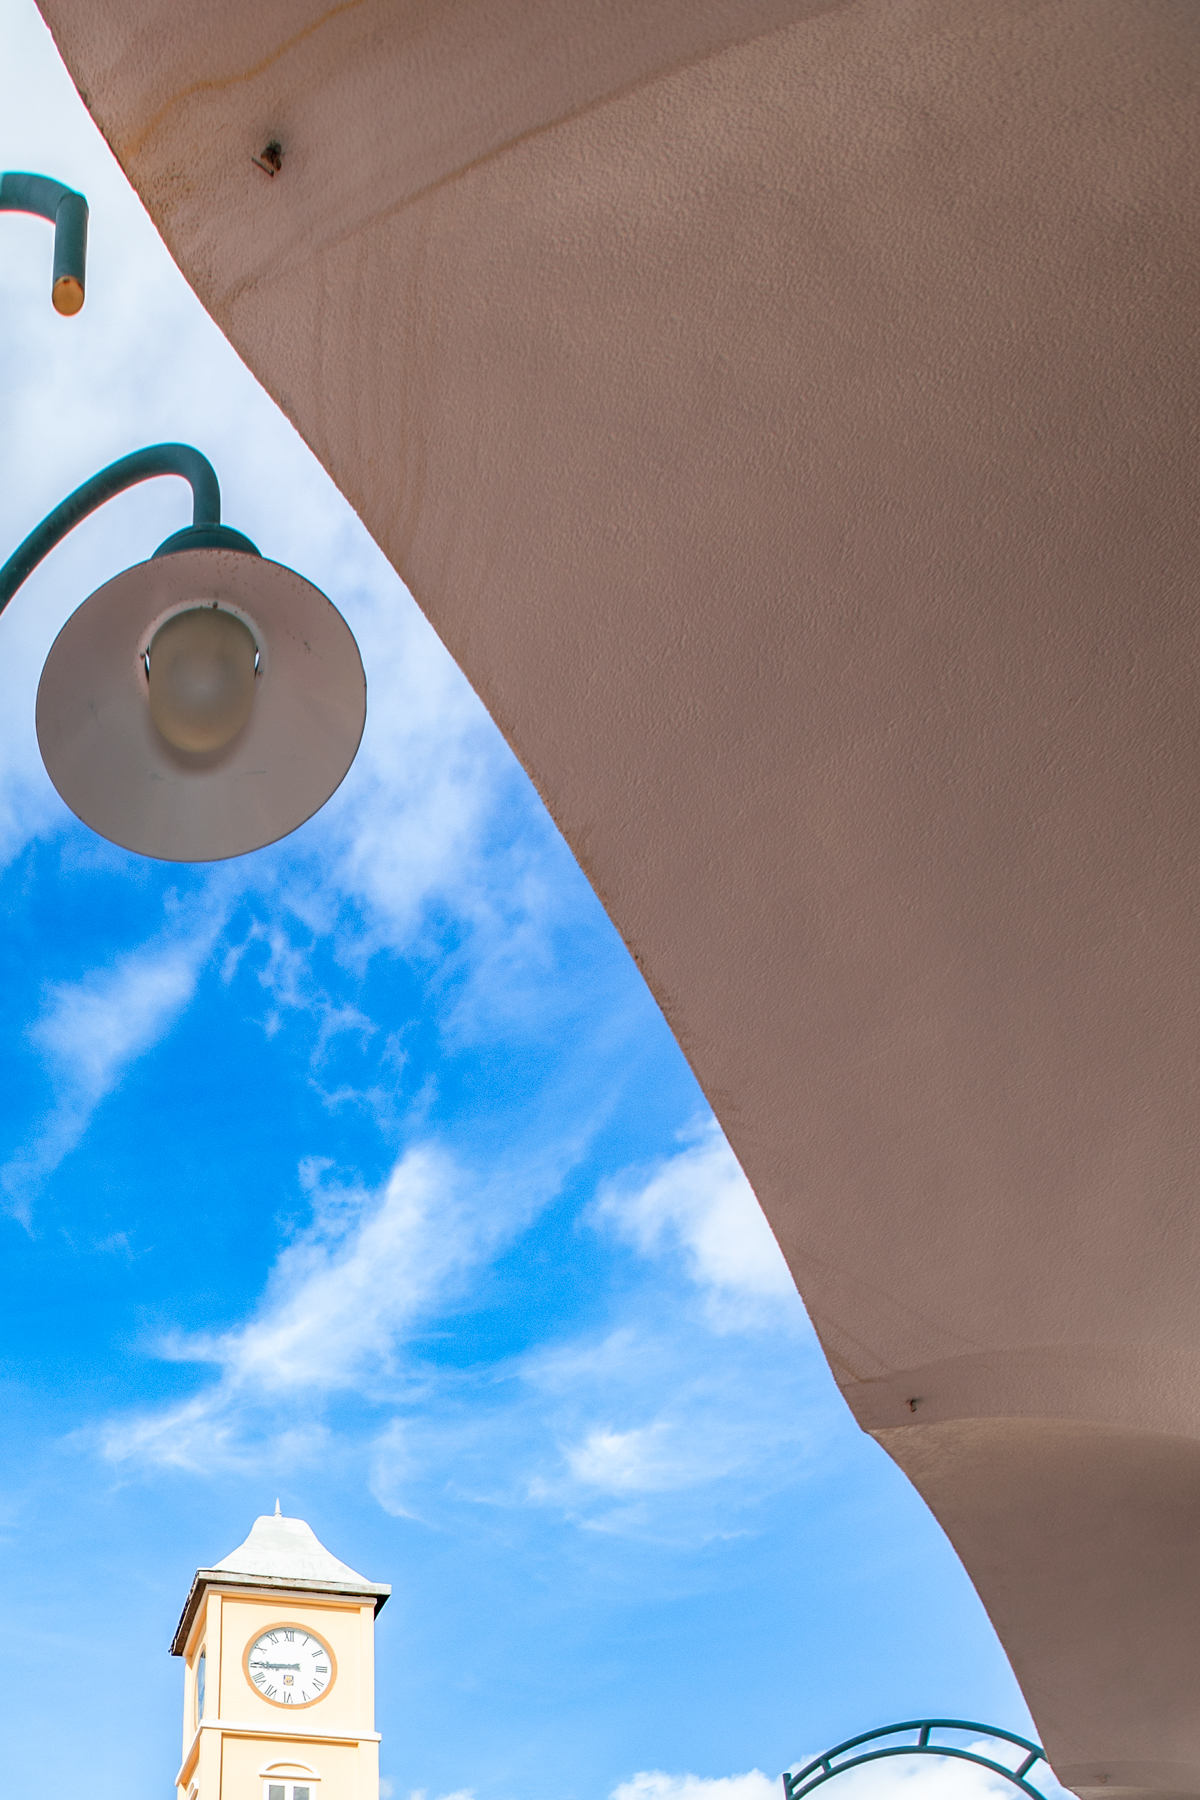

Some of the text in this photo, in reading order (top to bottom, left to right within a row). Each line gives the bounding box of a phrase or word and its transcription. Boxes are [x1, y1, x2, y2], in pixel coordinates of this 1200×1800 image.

[266, 1632, 279, 1645] XI
[284, 1630, 294, 1642] XII
[254, 1643, 267, 1654] X
[311, 1649, 323, 1658] II
[315, 1665, 328, 1673] III
[302, 1690, 311, 1701] V
